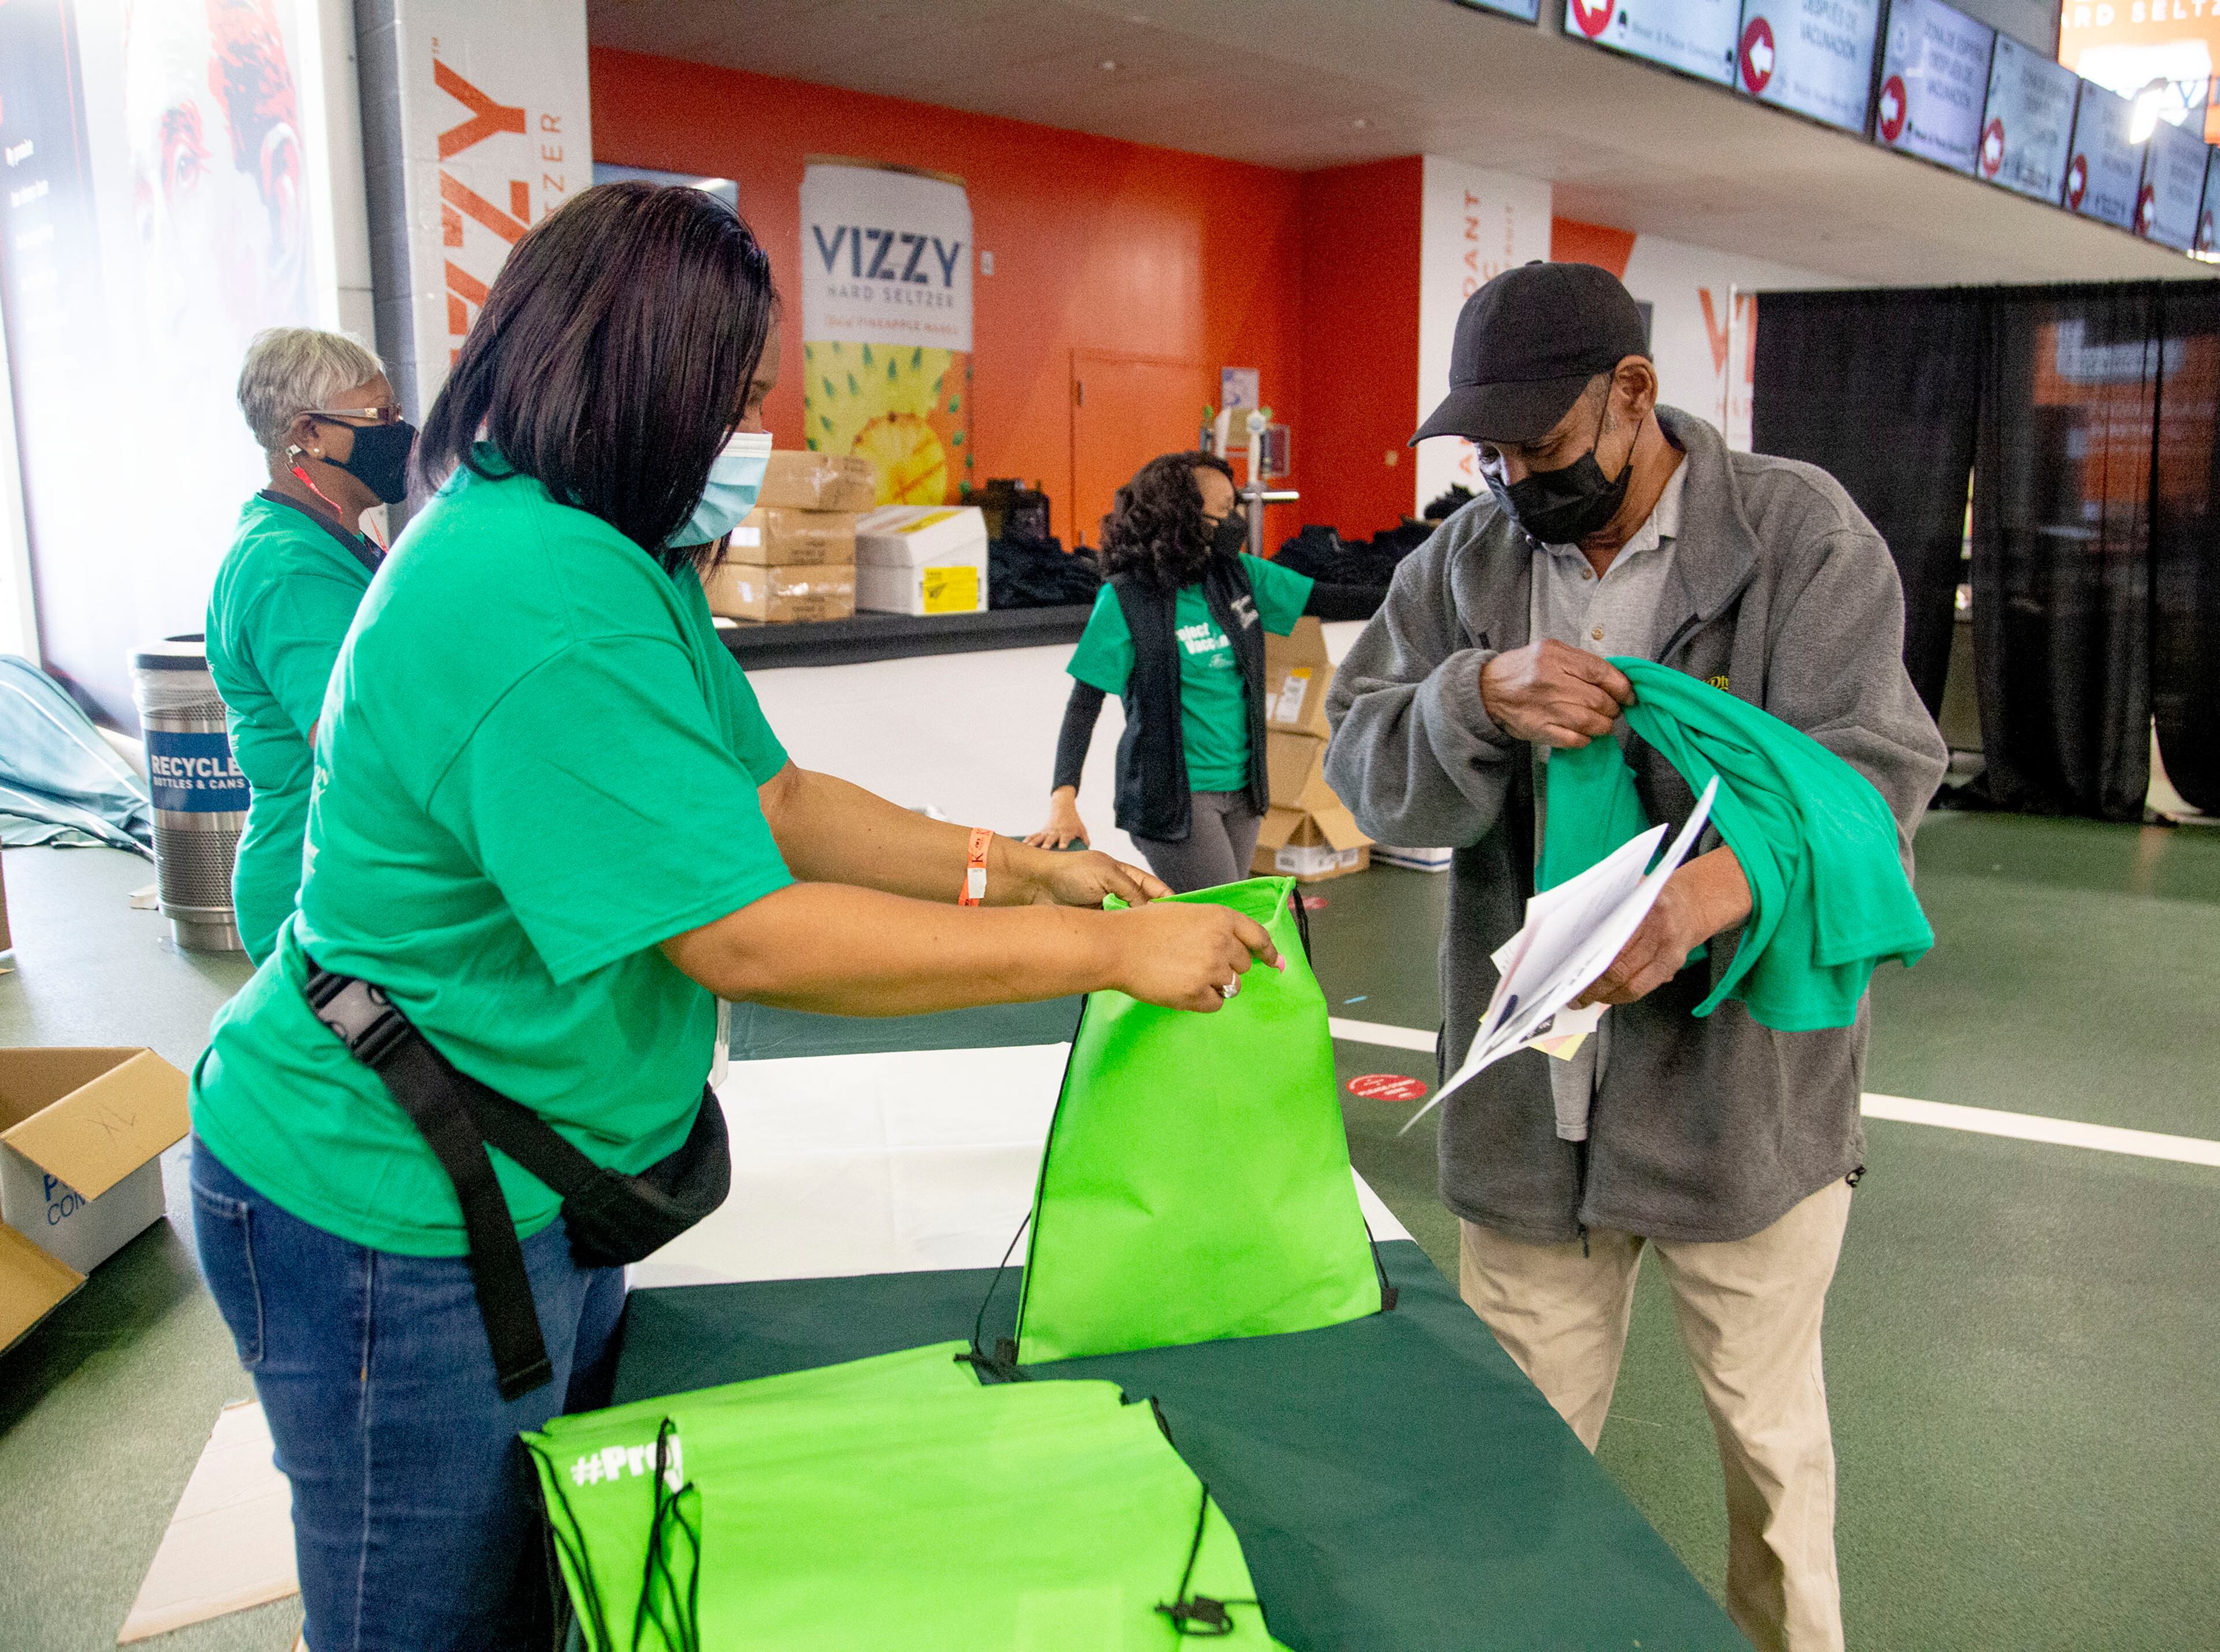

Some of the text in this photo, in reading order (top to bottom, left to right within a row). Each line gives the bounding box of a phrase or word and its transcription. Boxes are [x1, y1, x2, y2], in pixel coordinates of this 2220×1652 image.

[812, 224, 961, 287] VIZZY
[827, 286, 953, 307] HARD SELTZER
[151, 755, 244, 777] RECYCLE
[209, 779, 245, 789] CANS
